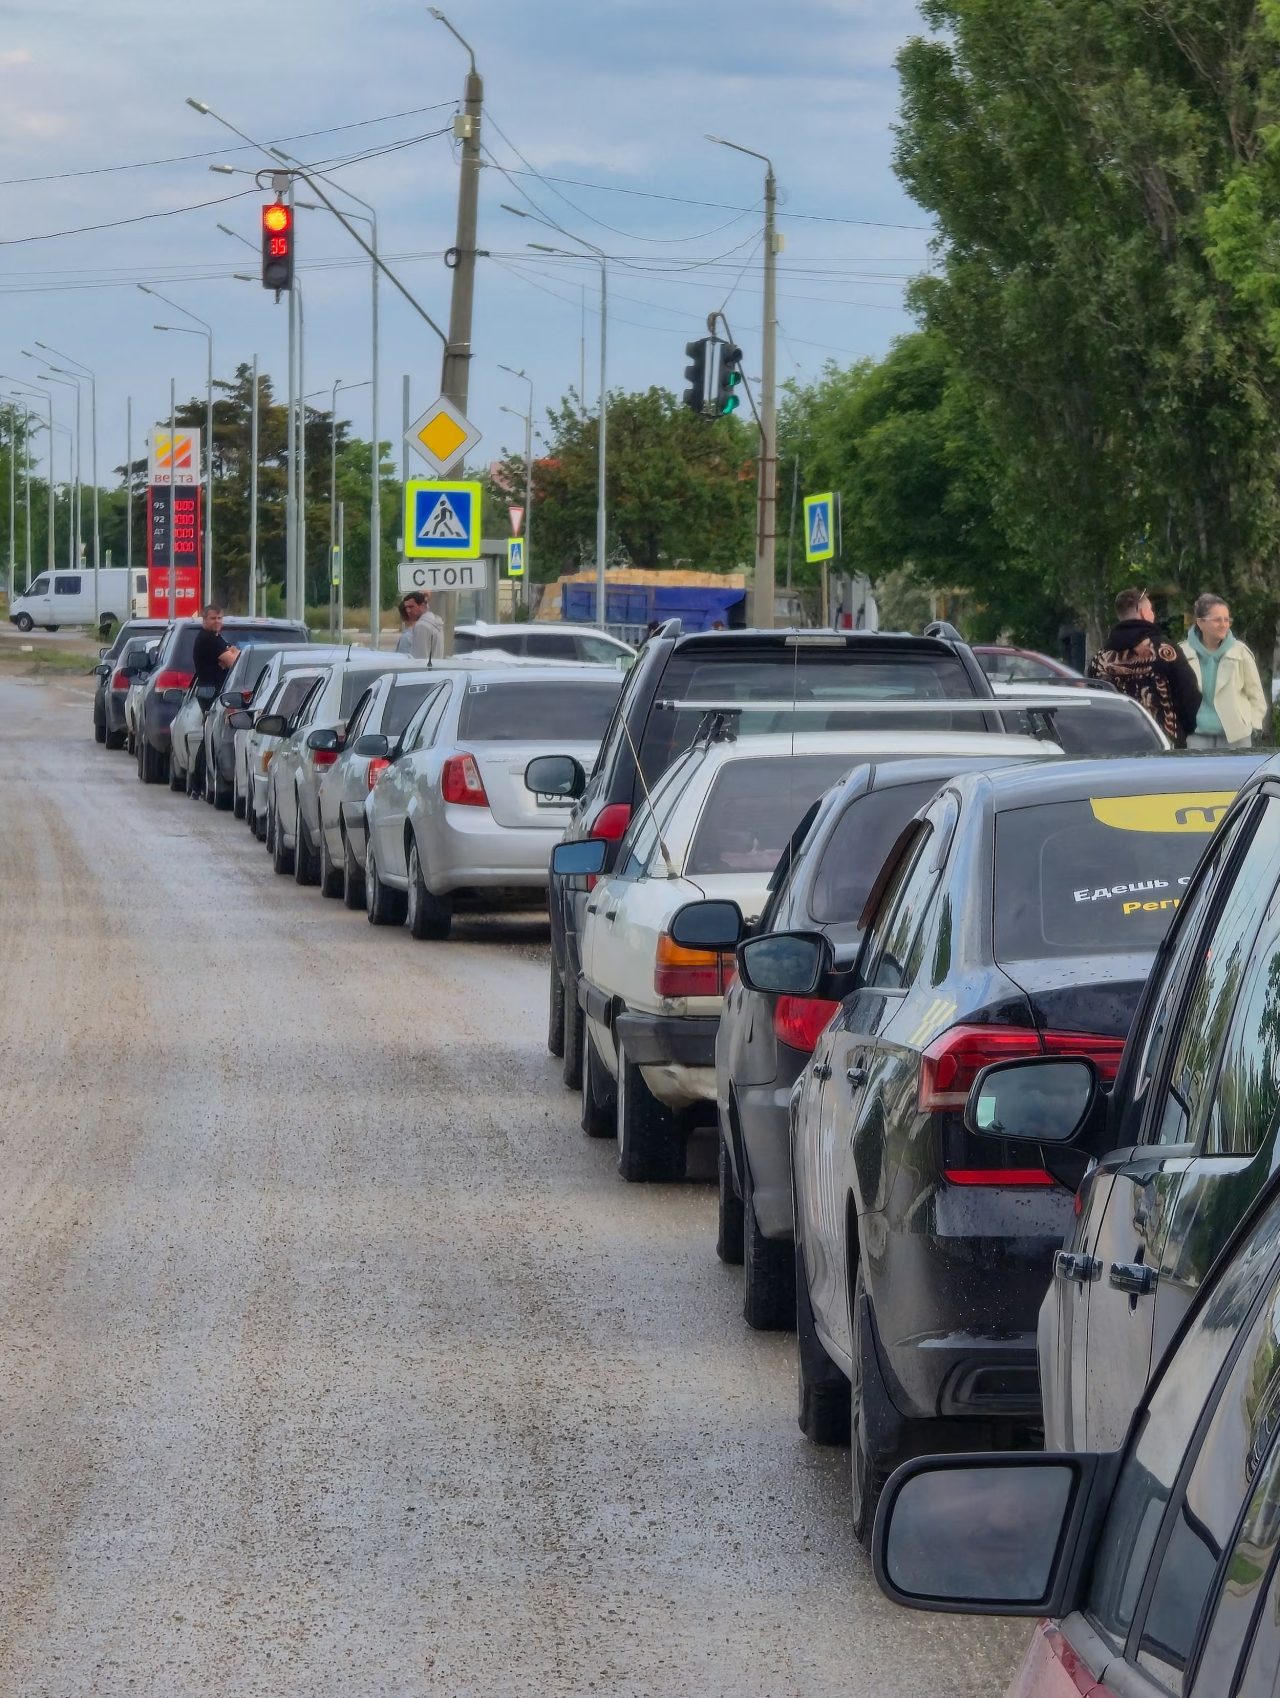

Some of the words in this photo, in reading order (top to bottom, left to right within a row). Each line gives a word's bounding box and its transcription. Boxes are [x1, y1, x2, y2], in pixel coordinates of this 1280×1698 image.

[153, 501, 164, 509] 95
[153, 515, 165, 523] 92
[413, 567, 473, 586] СТОП
[1073, 880, 1169, 902] Едешь
